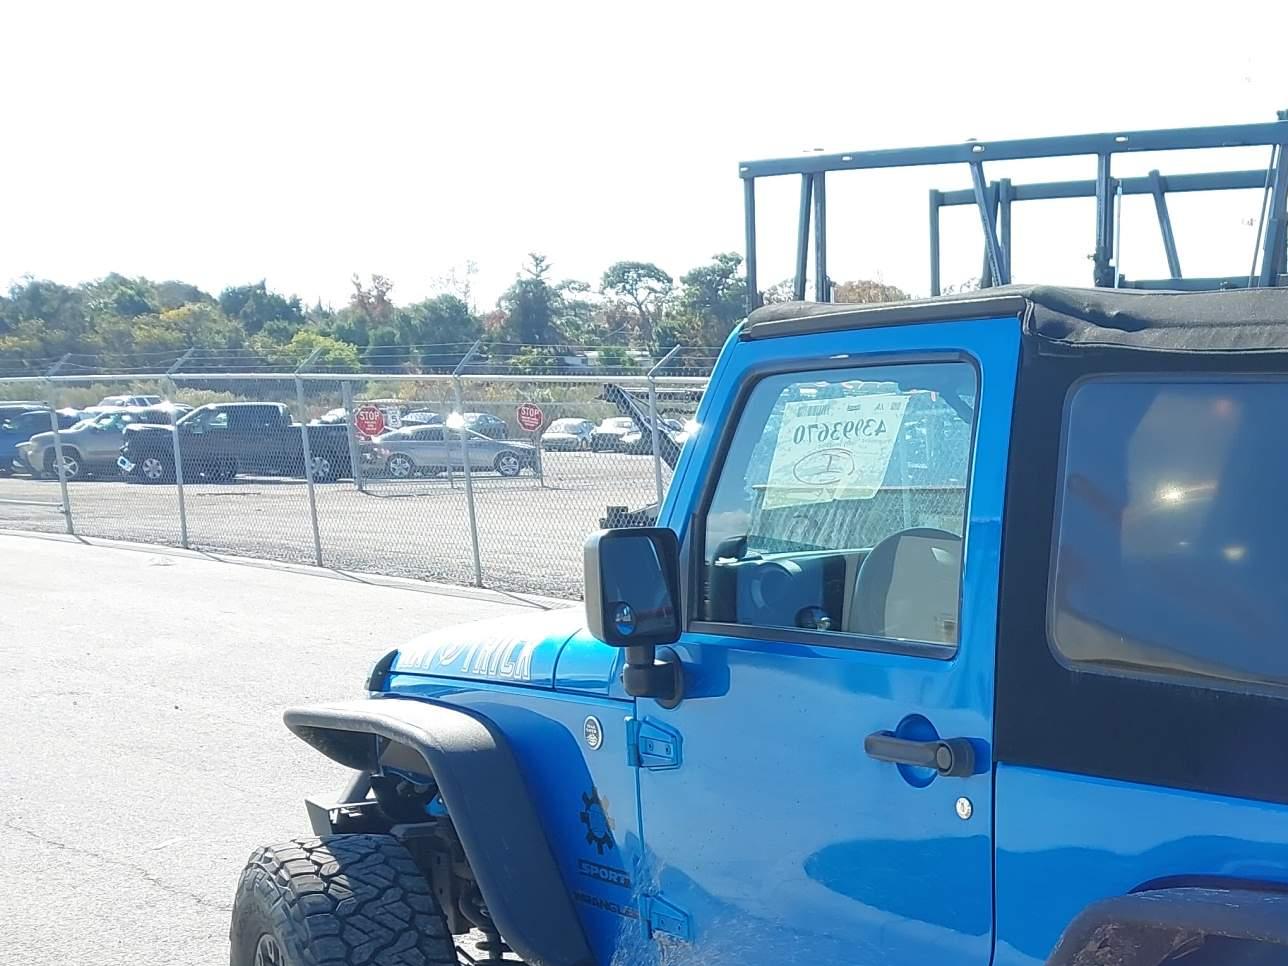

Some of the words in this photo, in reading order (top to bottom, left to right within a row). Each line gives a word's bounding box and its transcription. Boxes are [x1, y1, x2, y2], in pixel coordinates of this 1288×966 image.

[359, 411, 380, 421] STOP
[520, 406, 540, 417] STOP
[580, 863, 627, 885] SPORT
